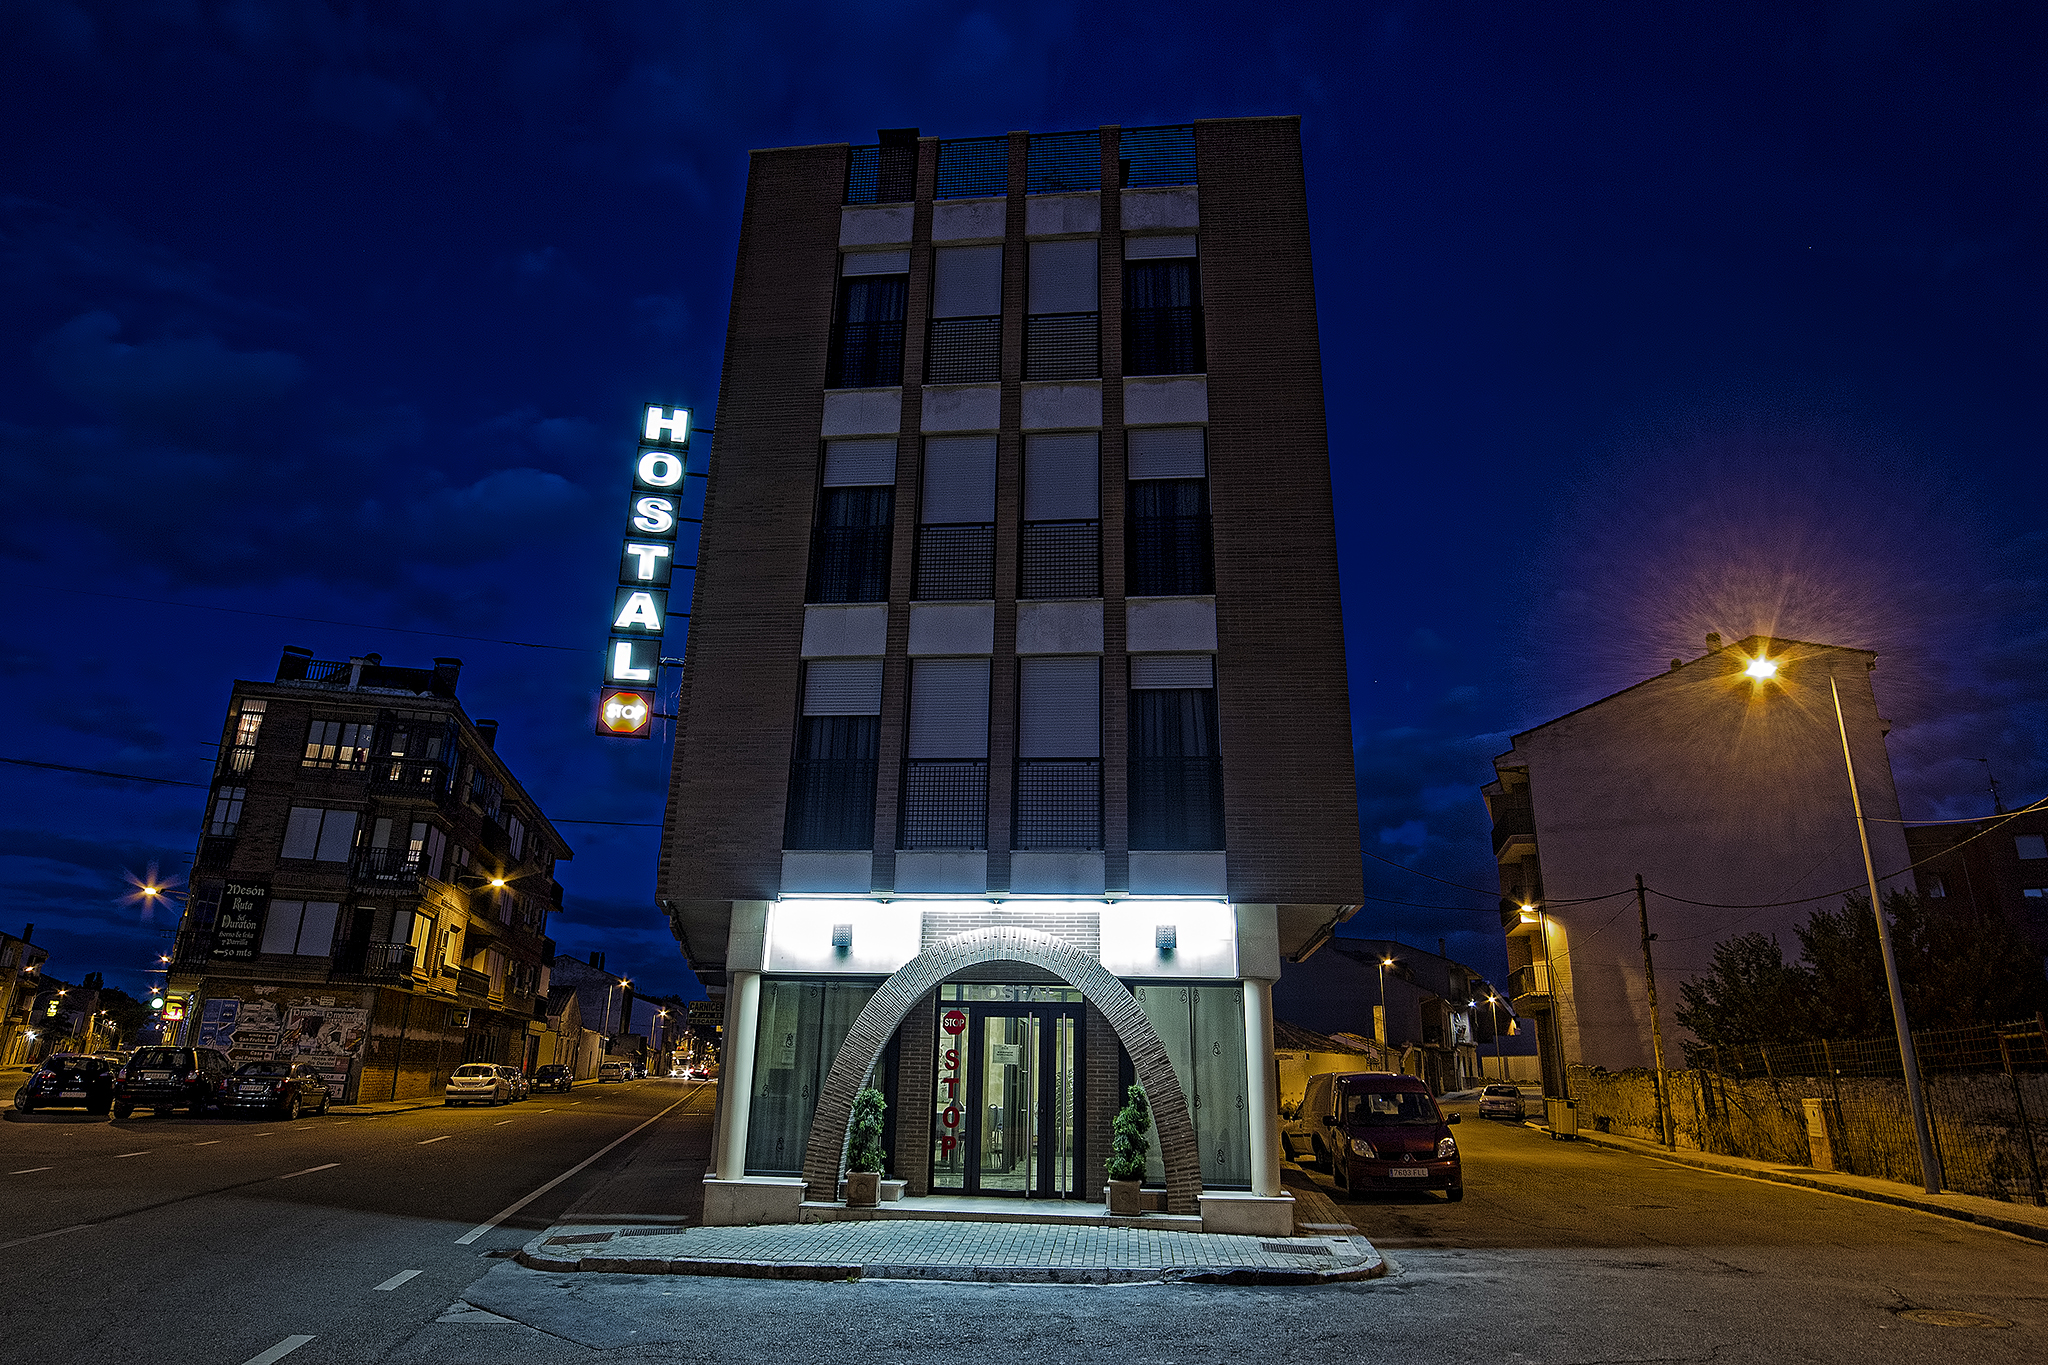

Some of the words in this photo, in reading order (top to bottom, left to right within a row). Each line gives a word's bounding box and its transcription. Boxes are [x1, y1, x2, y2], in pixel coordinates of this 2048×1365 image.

[613, 406, 689, 682] HOSTAL
[606, 703, 646, 720] STOP
[227, 884, 265, 896] Mesón
[232, 897, 253, 911] Ruta
[221, 914, 257, 929] Duratón
[968, 985, 1057, 1002] HOSTAL
[944, 1019, 965, 1027] STOP
[942, 1049, 960, 1158] STOP
